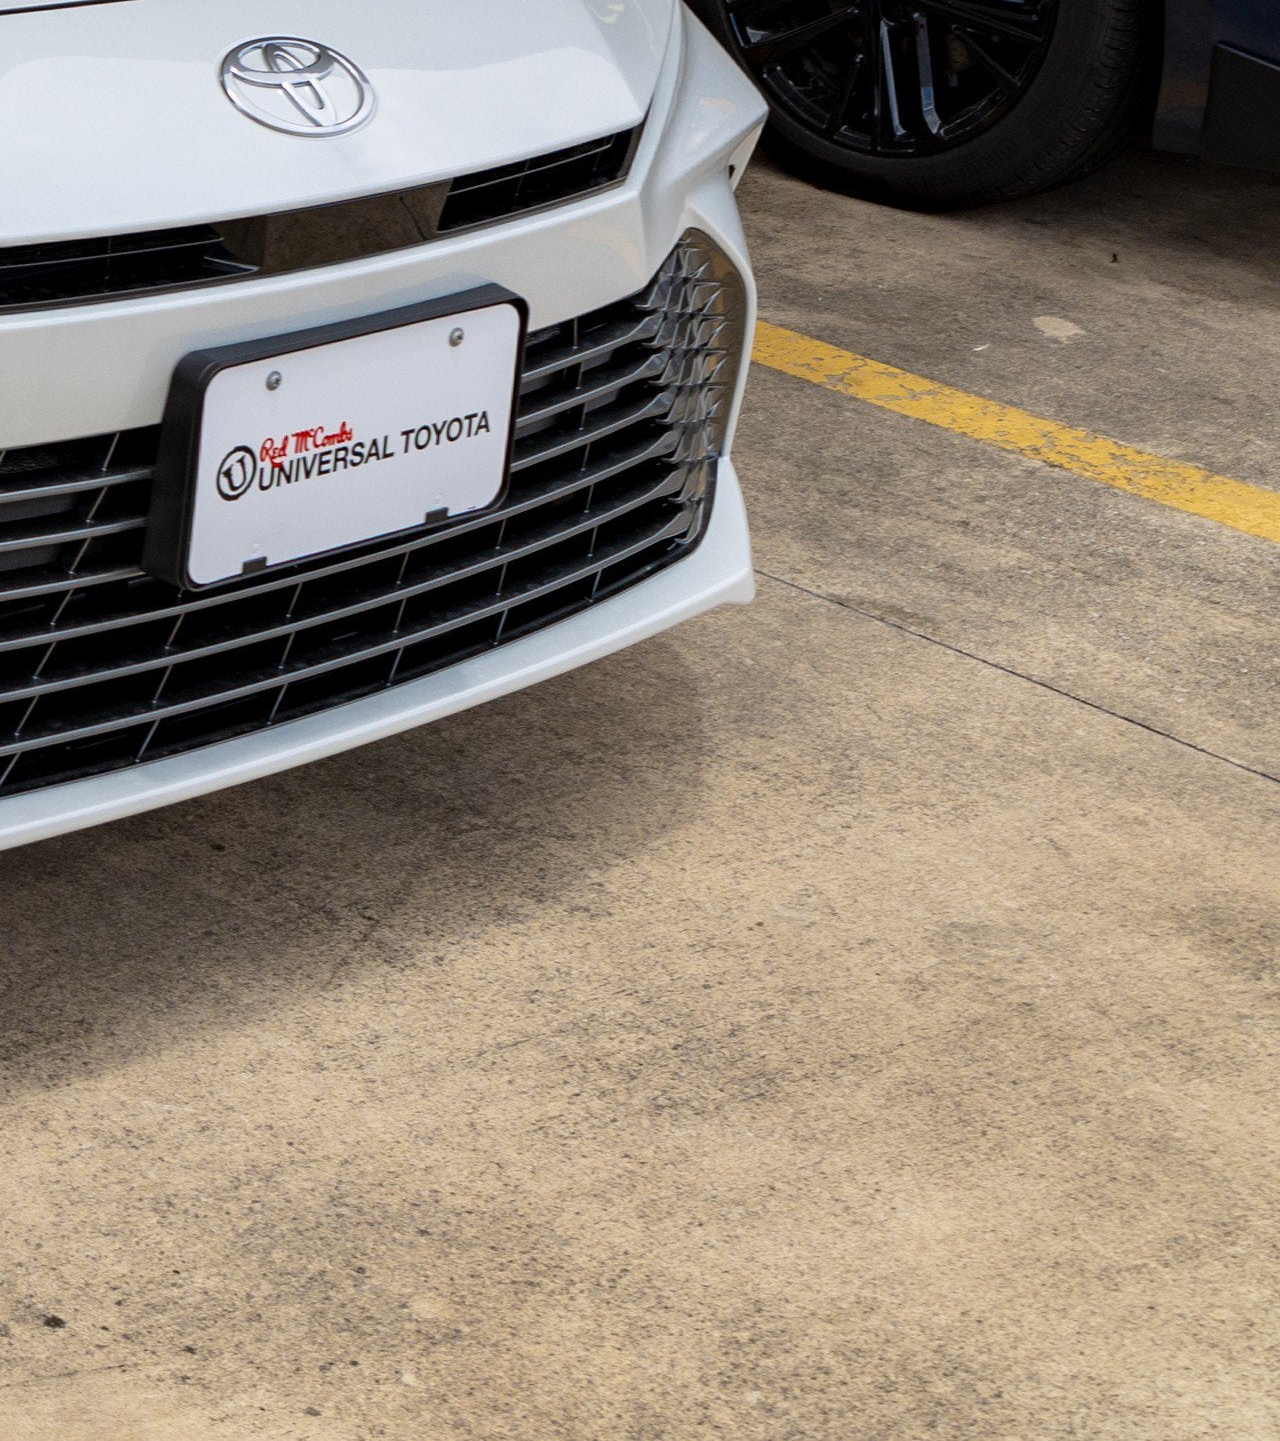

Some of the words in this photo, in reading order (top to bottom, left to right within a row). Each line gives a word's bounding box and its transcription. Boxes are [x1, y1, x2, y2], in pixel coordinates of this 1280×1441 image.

[258, 435, 395, 492] UNIVERSAL
[401, 411, 491, 454] TOYOTA
[260, 434, 289, 463] Red
